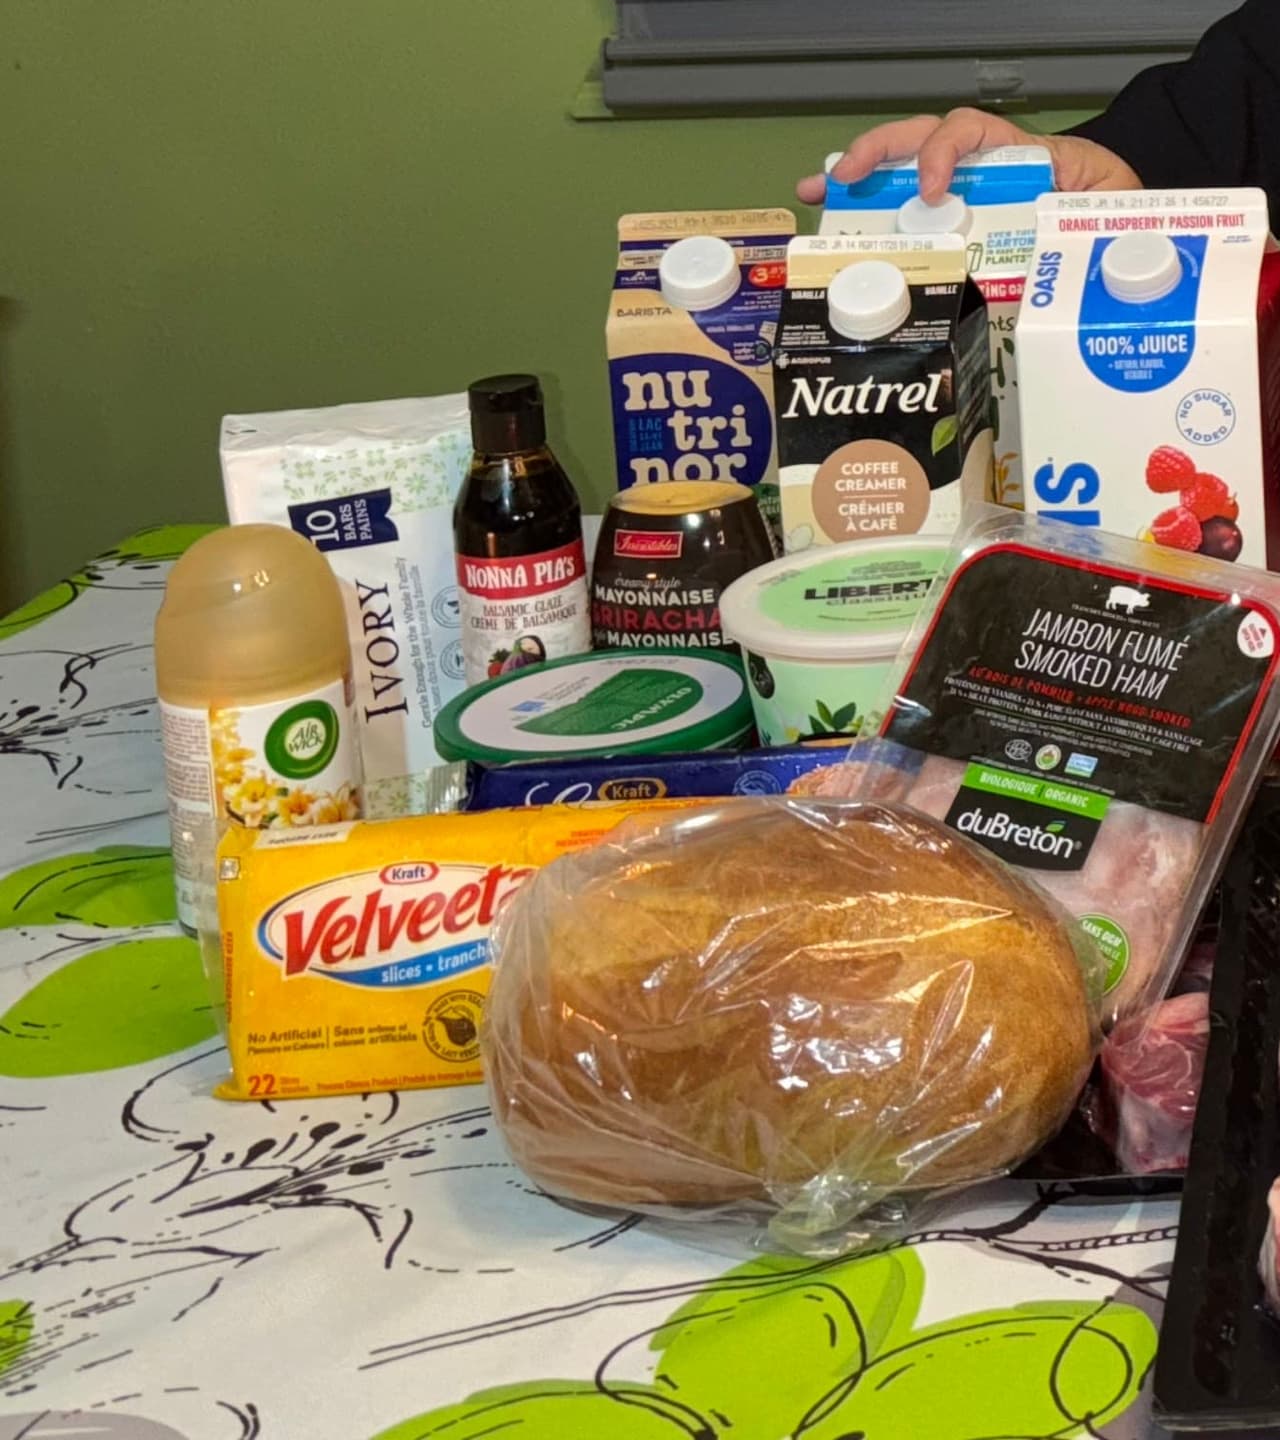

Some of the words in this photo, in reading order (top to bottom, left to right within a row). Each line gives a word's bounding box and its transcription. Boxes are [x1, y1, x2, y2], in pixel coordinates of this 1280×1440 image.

[1058, 217, 1100, 233] ORANGE
[1104, 216, 1165, 231] RASPBERRY
[1169, 215, 1214, 229] PASSION
[1216, 213, 1246, 228] FRUIT
[987, 237, 1036, 248] CARTON
[986, 255, 1026, 264] PLANTS
[925, 285, 958, 296] VANILLE
[1031, 250, 1062, 308] OASIS
[791, 290, 825, 300] VANILLA
[617, 307, 673, 318] BARISTA
[1085, 336, 1135, 356] 100%
[1138, 333, 1188, 354] JUICE
[622, 370, 713, 411] nu
[782, 373, 942, 417] Natrel
[1180, 400, 1193, 419] NO
[1194, 392, 1232, 417] SUGAR
[667, 404, 752, 451] tri
[1184, 425, 1228, 442] ADDED
[630, 452, 747, 486] nor
[840, 461, 898, 475] COFFEE
[835, 477, 906, 492] CREAMER
[353, 498, 373, 540] PAINS
[838, 499, 904, 516] CRÉMIER
[338, 503, 357, 541] BARS
[859, 515, 897, 531] CAFÉ
[465, 564, 527, 589] NONNA
[534, 556, 575, 586] PIA'S
[595, 584, 715, 606] MAYONNAISE
[614, 576, 650, 592] creamy
[654, 576, 682, 593] style
[805, 578, 934, 600] LIBERT
[401, 591, 414, 624] Whole
[483, 601, 530, 618] BALSAMIC
[534, 595, 564, 613] GLAZE
[504, 617, 517, 630] DE
[522, 606, 578, 628] BALSAMIQUE
[355, 578, 410, 724] IVORY
[1023, 608, 1120, 656] JAMBON
[1119, 632, 1191, 672] FUMÉ
[412, 658, 428, 694] Enough
[1015, 641, 1111, 688] SMOKED
[1112, 663, 1169, 700] HAM
[1026, 678, 1075, 703] POMMIER
[1085, 695, 1115, 711] APPLE
[418, 697, 432, 728] Gentle
[611, 687, 693, 730] OLYMPIC
[612, 783, 651, 799] Kraft
[980, 772, 1039, 795] BIOLOGIQUE
[1044, 788, 1089, 808] ORGANIC
[957, 808, 1074, 858] duBreton
[391, 866, 426, 880] Kraft
[381, 962, 421, 984] slices
[437, 942, 487, 972] tranch
[248, 1033, 266, 1044] No
[269, 1027, 322, 1043] Artificial
[333, 1025, 365, 1037] Sans
[248, 1074, 277, 1096] 22
